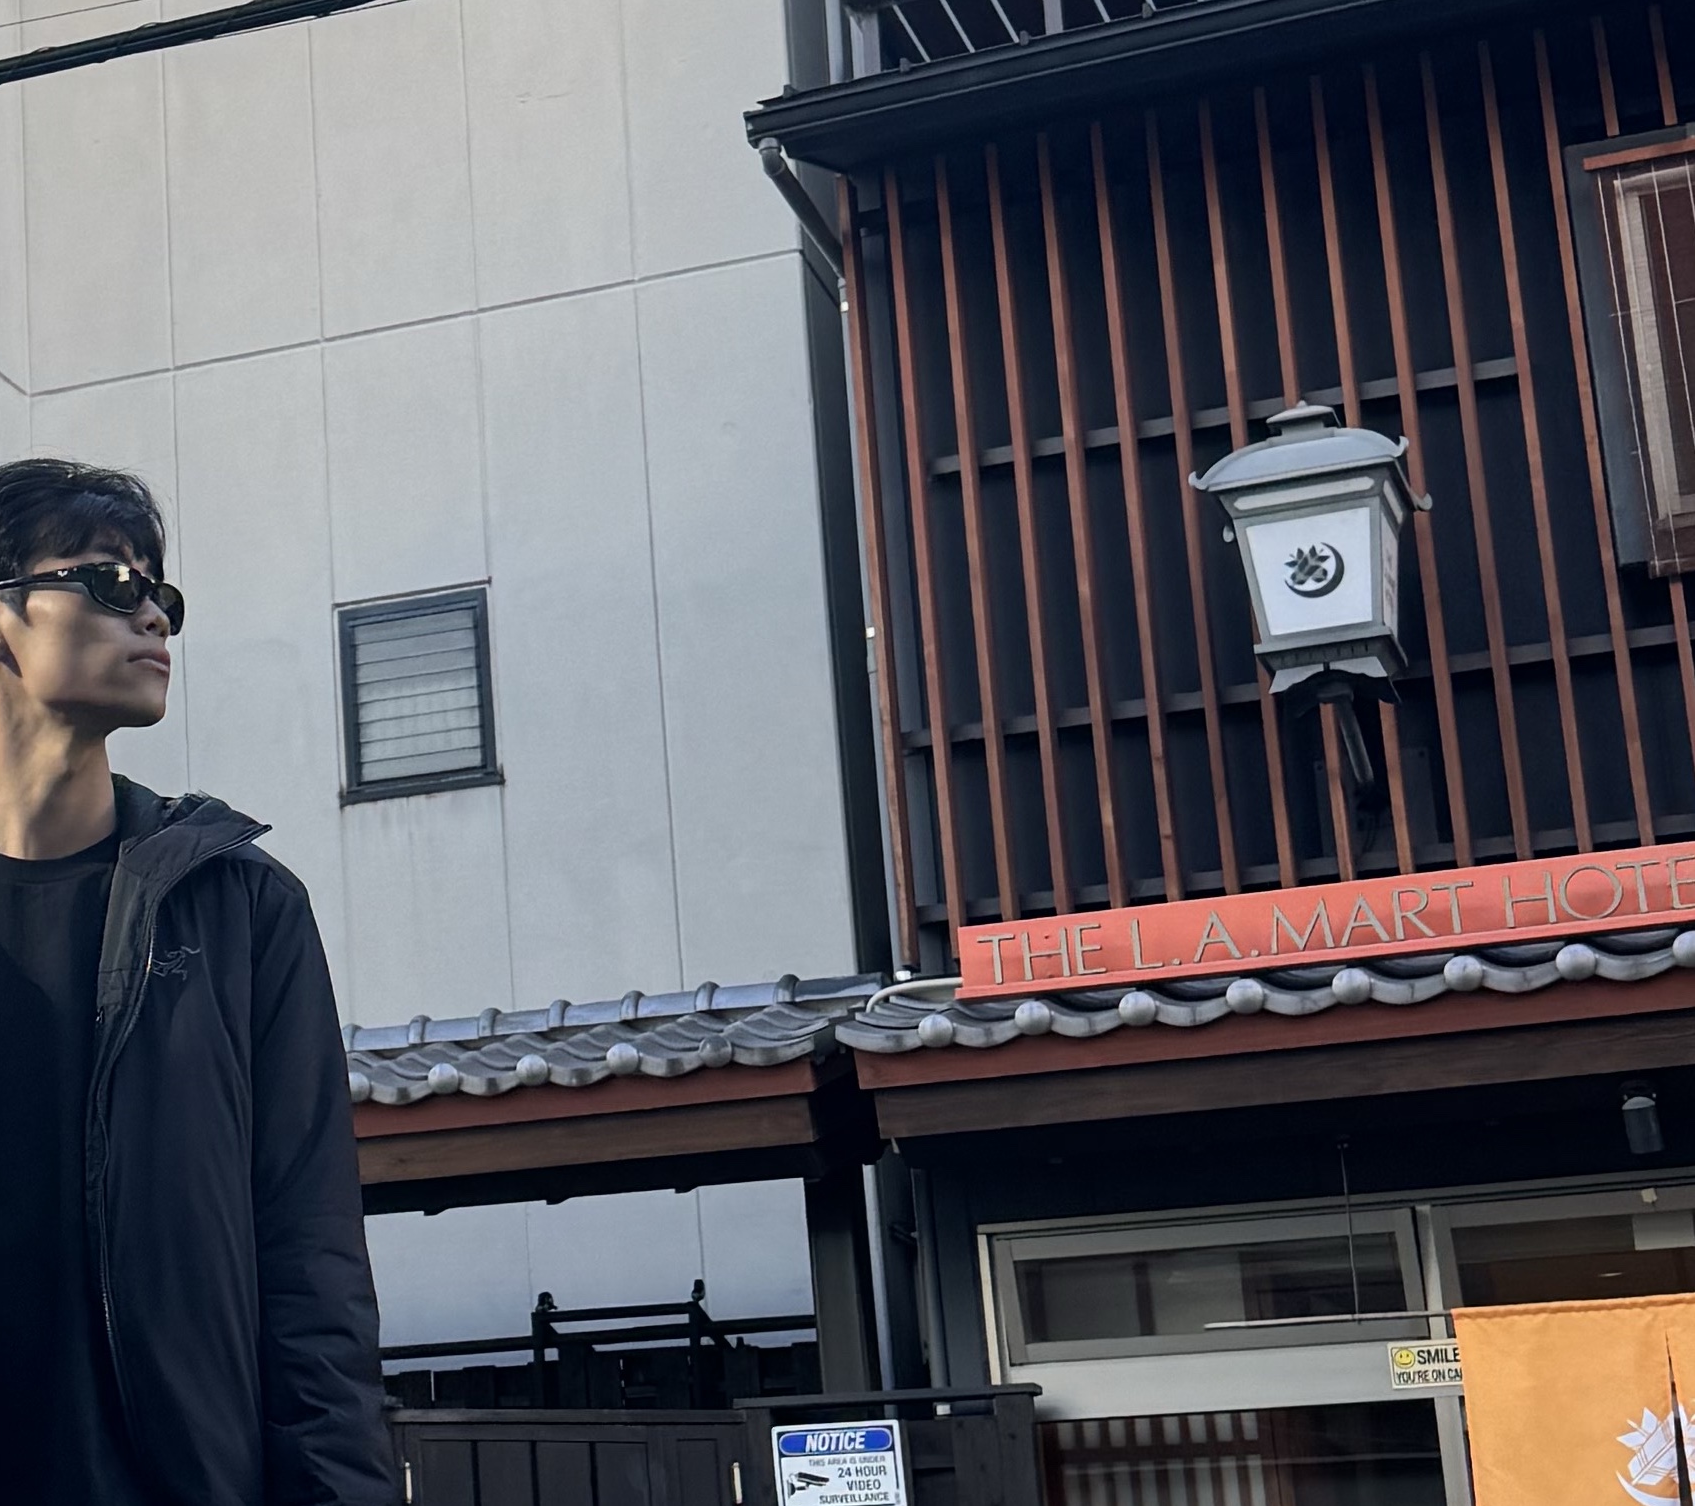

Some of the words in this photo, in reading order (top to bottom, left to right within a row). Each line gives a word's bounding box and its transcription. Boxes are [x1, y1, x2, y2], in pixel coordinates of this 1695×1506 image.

[977, 923, 1106, 984] THE
[1130, 881, 1473, 970] L.A.MART
[1417, 1347, 1461, 1365] SMILE
[1448, 1367, 1462, 1381] CA
[806, 1432, 866, 1452] NOTICE
[837, 1467, 852, 1478] 24
[855, 1465, 887, 1476] HOUR
[846, 1479, 881, 1491] VIDEO
[819, 1492, 889, 1505] SURVEILLANCE
